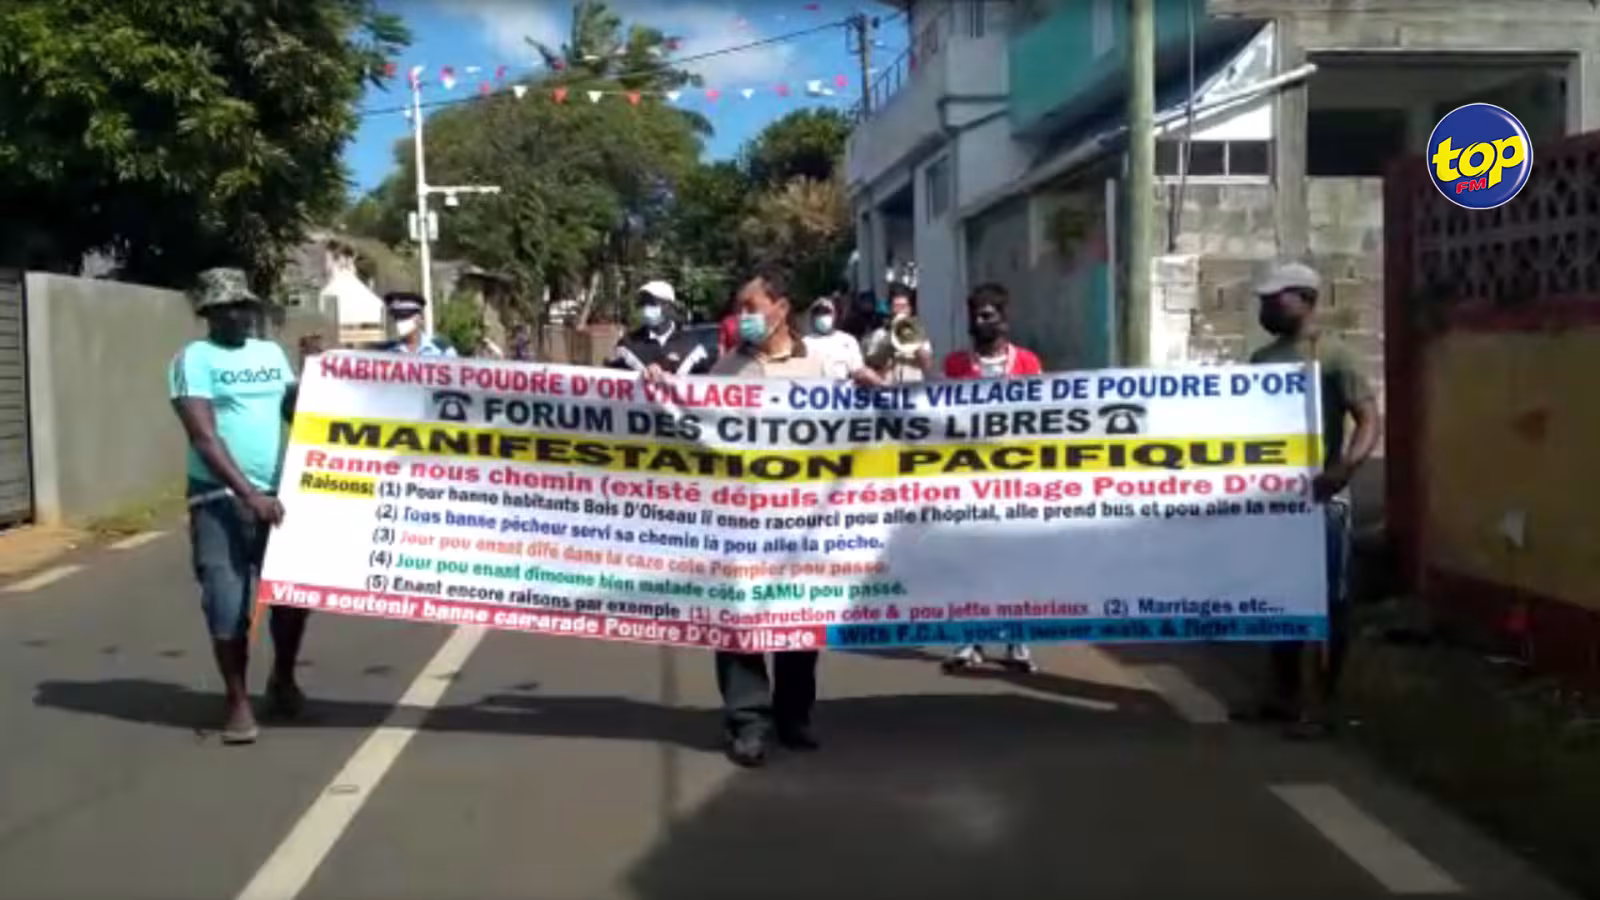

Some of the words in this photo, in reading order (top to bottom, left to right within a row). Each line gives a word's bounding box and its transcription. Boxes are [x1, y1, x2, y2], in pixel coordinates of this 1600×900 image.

[321, 354, 452, 386] HABITANTS
[460, 366, 562, 394] POUDRE
[571, 373, 634, 399] D'OR
[643, 381, 765, 408] VILLAGE
[789, 385, 916, 410] CONSEIL
[925, 379, 1043, 407] VILLAGE
[1052, 378, 1088, 400] DE
[1097, 374, 1221, 399] POUDRE
[1230, 372, 1307, 396] D'OR
[484, 400, 613, 432] FORUM
[627, 410, 701, 441] DES
[717, 416, 931, 444] CITOYENS
[945, 408, 1091, 440] LIBRES
[328, 422, 854, 480] MANIFESTATION
[897, 441, 1288, 474] PACIFIQUE
[300, 472, 375, 495] Raisons:
[378, 482, 401, 499] (1)
[502, 491, 580, 513] habitants
[584, 499, 618, 517] Bois
[765, 511, 840, 530] racourci
[844, 511, 878, 528] pou
[1043, 502, 1096, 522] prend
[1101, 501, 1135, 517] bus
[1140, 502, 1160, 517] et
[1165, 502, 1200, 520] pou
[304, 450, 401, 476] Ranne
[410, 462, 481, 482] nous
[489, 466, 594, 492] chemin
[600, 476, 702, 502] (existé
[711, 484, 818, 511] dépuis
[829, 482, 960, 505] création
[971, 479, 1083, 502] Village
[1093, 476, 1213, 497] Poudre
[1224, 474, 1310, 497] D'Or)
[373, 528, 396, 544] (3)
[439, 535, 471, 551] pou
[790, 562, 825, 577] pou
[376, 504, 398, 522] (2)
[615, 529, 634, 543] sa
[639, 529, 699, 548] chemin
[723, 538, 757, 554] pou
[763, 537, 797, 553] alle
[366, 575, 389, 592] (5)
[510, 589, 571, 608] raisons
[575, 597, 600, 612] par
[606, 602, 680, 619] exemple
[719, 608, 835, 625] Construction
[910, 603, 944, 623] pou
[1103, 599, 1129, 617] (2)
[1138, 598, 1234, 617] Marriages
[369, 550, 392, 568] (4)
[396, 553, 432, 569] Jour
[437, 558, 468, 574] pou
[639, 577, 704, 596] malade
[752, 584, 805, 601] SAMU
[810, 584, 843, 600] pou
[272, 583, 321, 604] Vine
[326, 591, 417, 615] soutenir
[494, 609, 599, 632] camarade
[605, 618, 680, 640] Poudre
[687, 624, 731, 646] D'Or
[737, 629, 815, 650] Village
